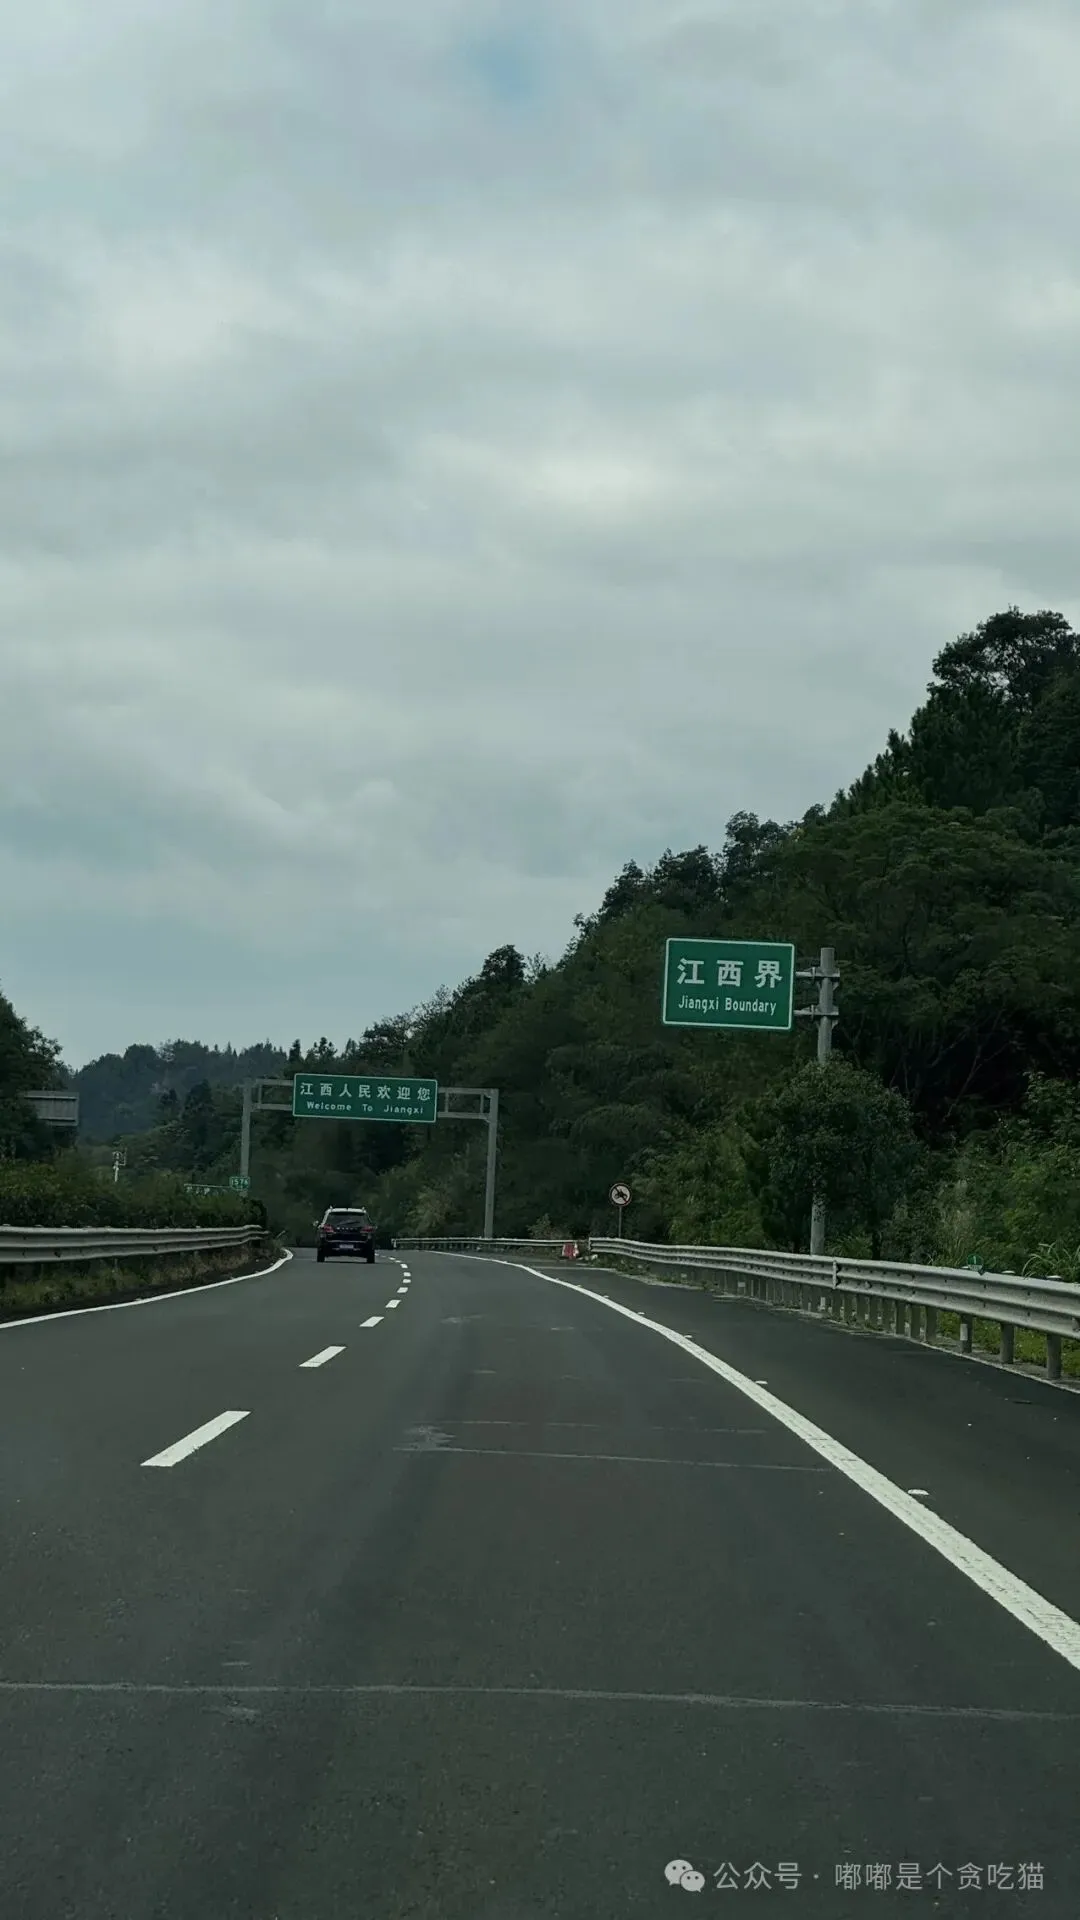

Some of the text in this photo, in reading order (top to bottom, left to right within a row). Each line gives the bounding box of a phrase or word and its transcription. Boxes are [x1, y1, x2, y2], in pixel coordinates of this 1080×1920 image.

[676, 957, 783, 989] 江西界
[678, 995, 777, 1016] Jiangxi Boundary
[300, 1082, 431, 1101] 江西人民欢迎您
[306, 1101, 423, 1115] Welcome To Jiangxi
